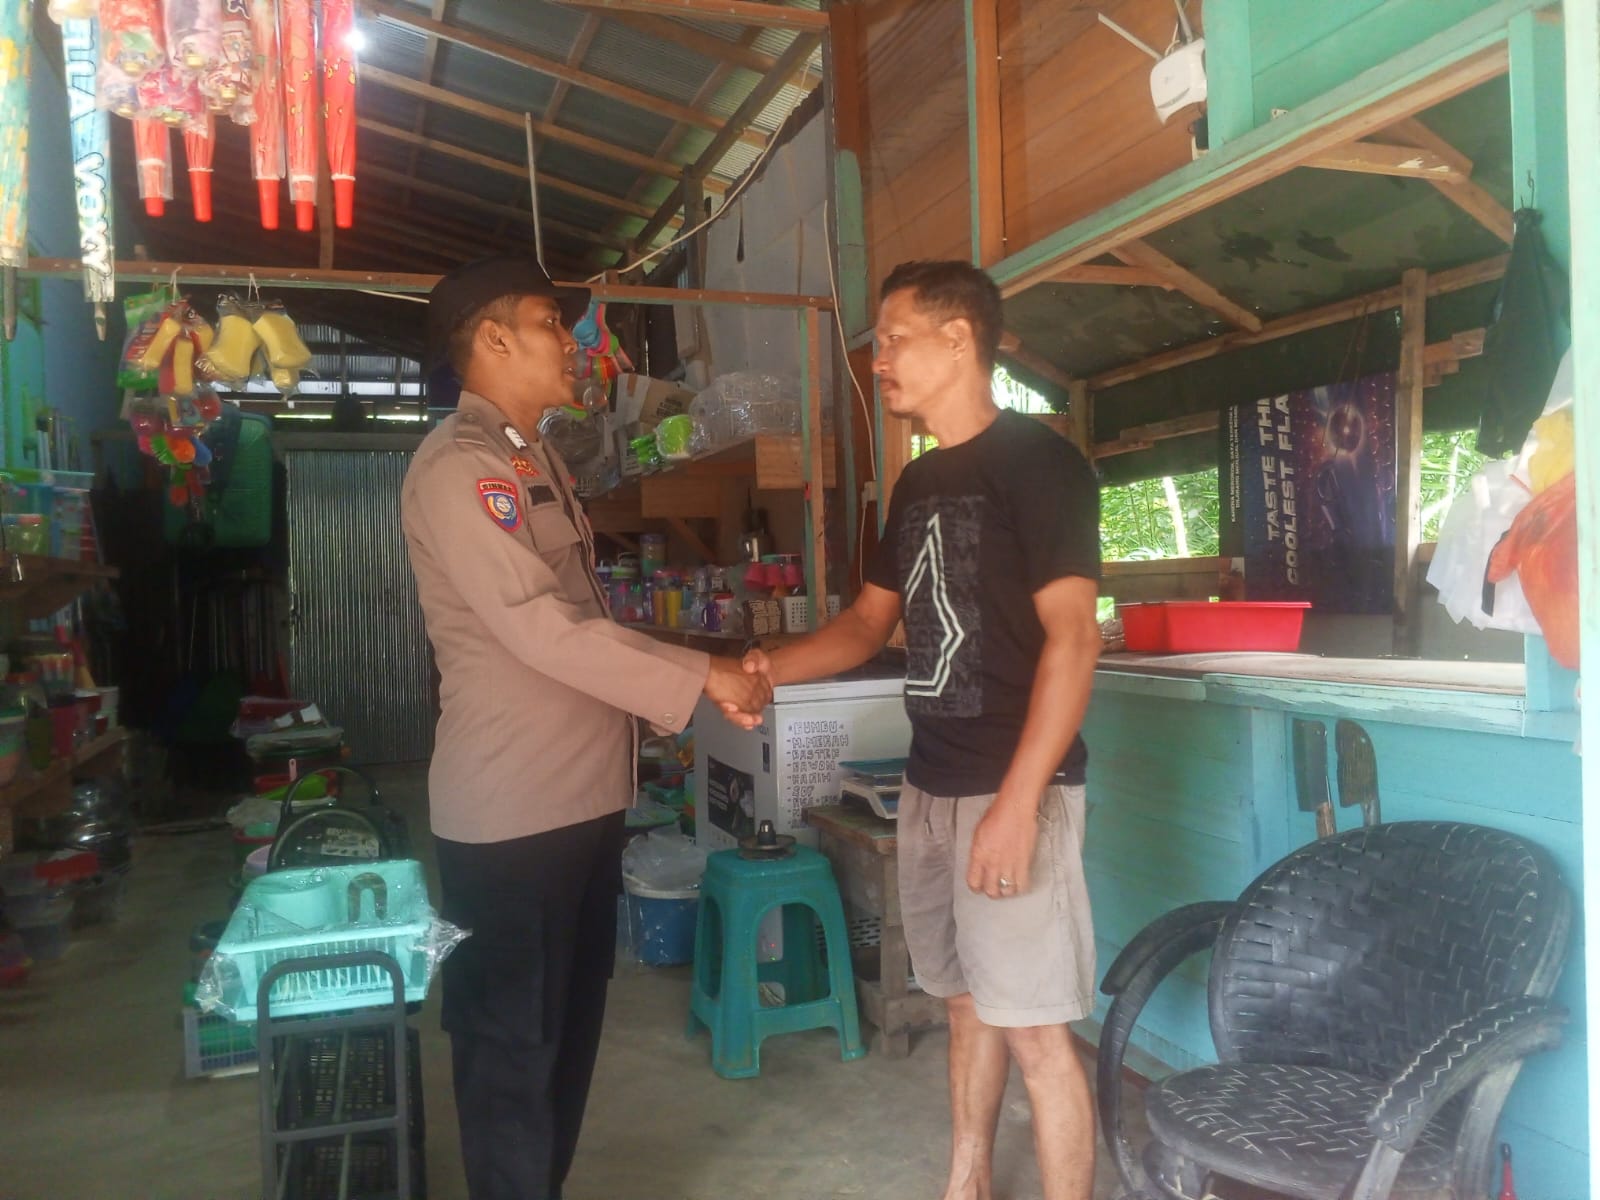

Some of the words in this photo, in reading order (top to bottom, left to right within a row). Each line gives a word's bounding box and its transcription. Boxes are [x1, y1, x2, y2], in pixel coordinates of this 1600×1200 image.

[1275, 394, 1293, 451] FLA
[1262, 455, 1279, 541] TASTE
[1280, 460, 1298, 585] COOLEST
